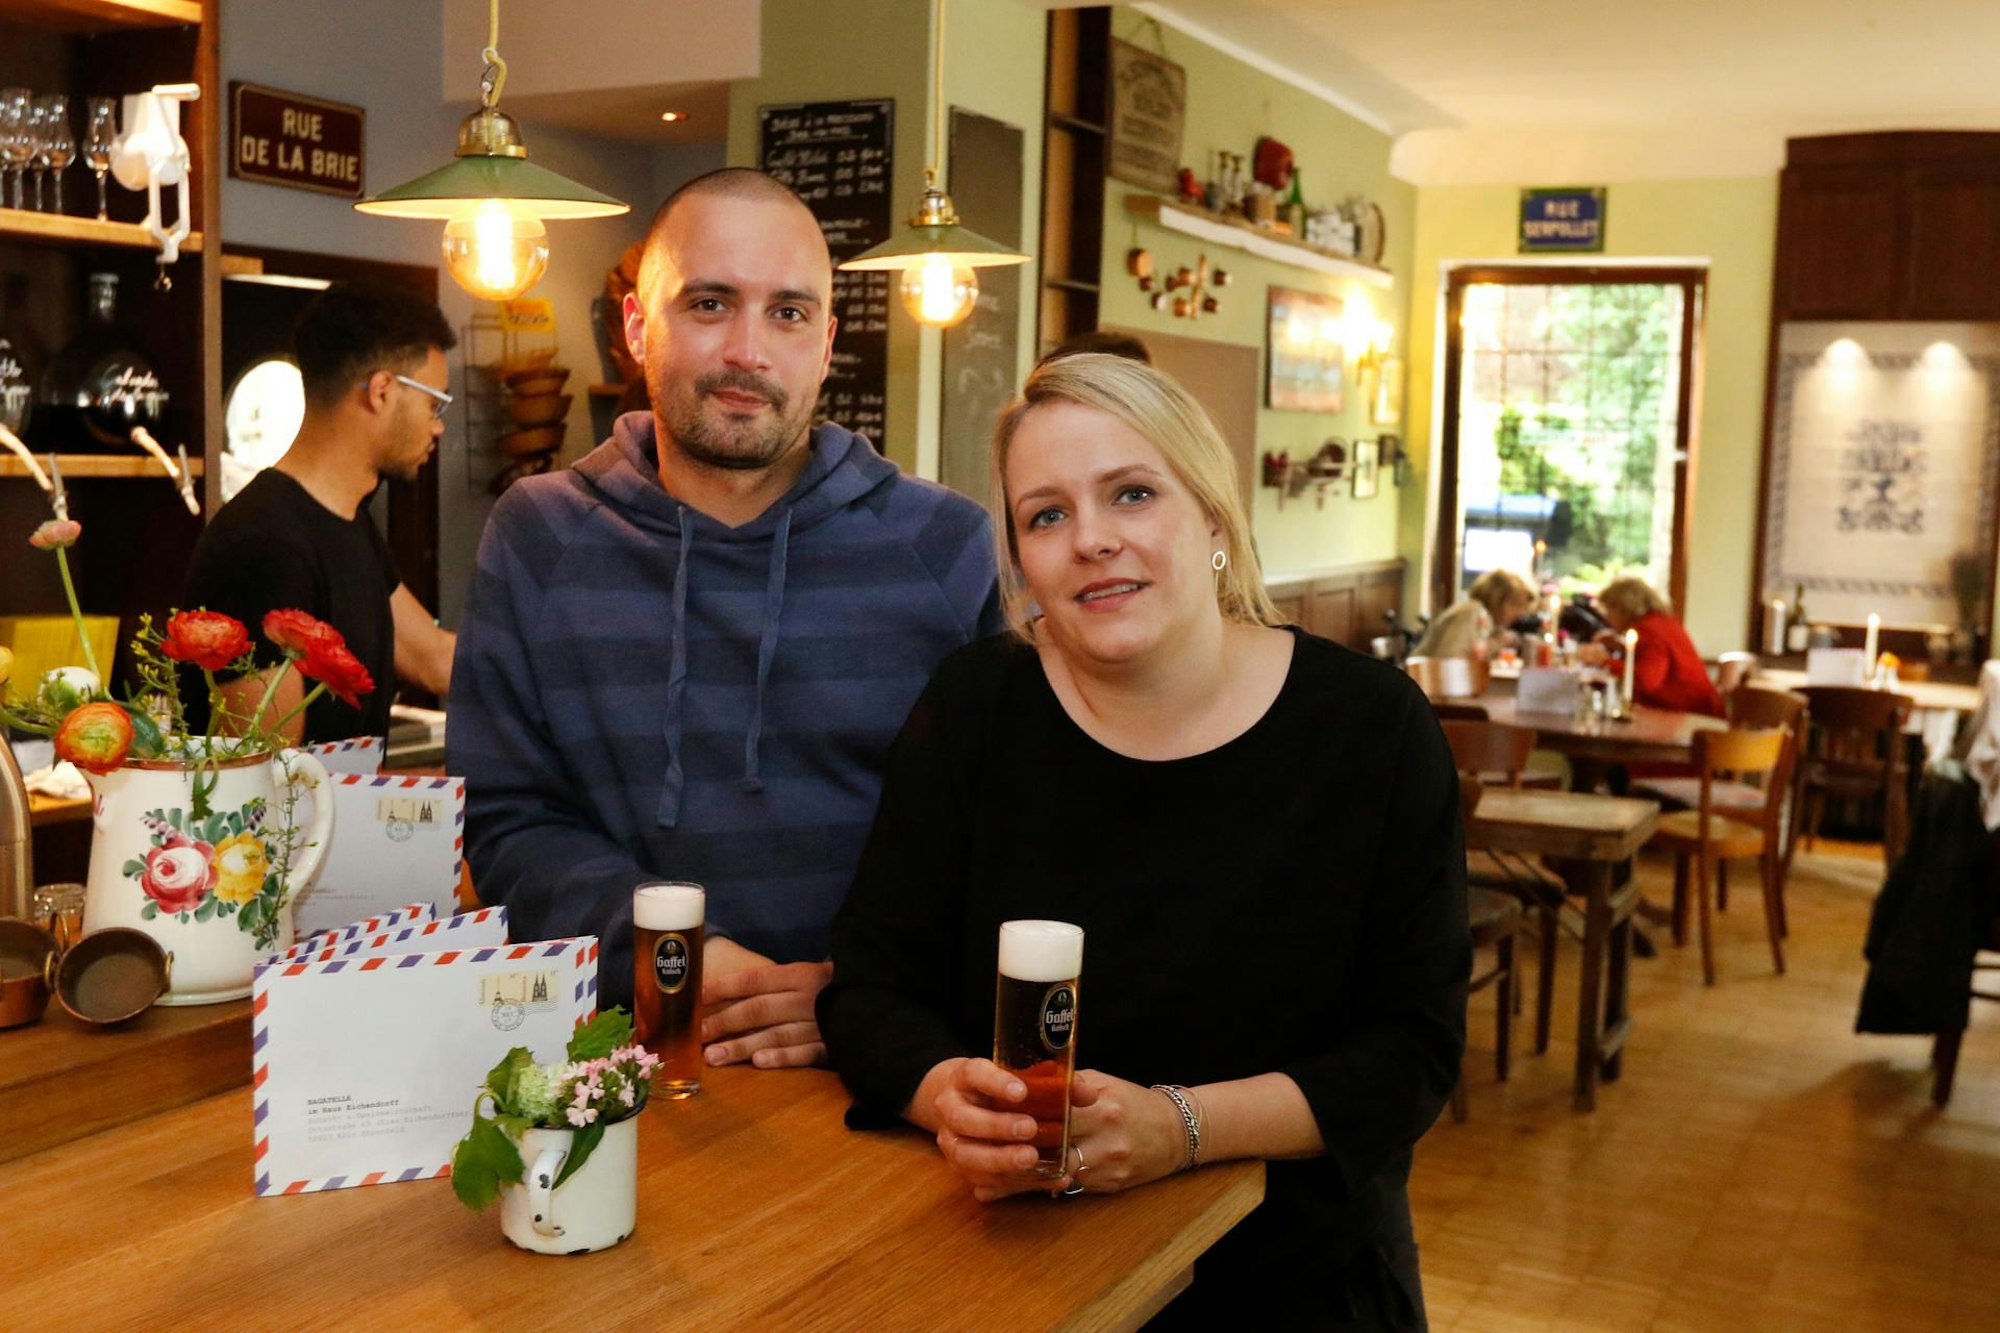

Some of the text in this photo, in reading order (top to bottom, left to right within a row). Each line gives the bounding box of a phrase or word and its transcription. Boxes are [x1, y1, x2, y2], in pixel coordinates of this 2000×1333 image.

[283, 108, 323, 142] RUE
[241, 135, 359, 182] DE LA BRIE
[656, 955, 686, 968] Gaffel
[1045, 1008, 1074, 1024] Gaffel
